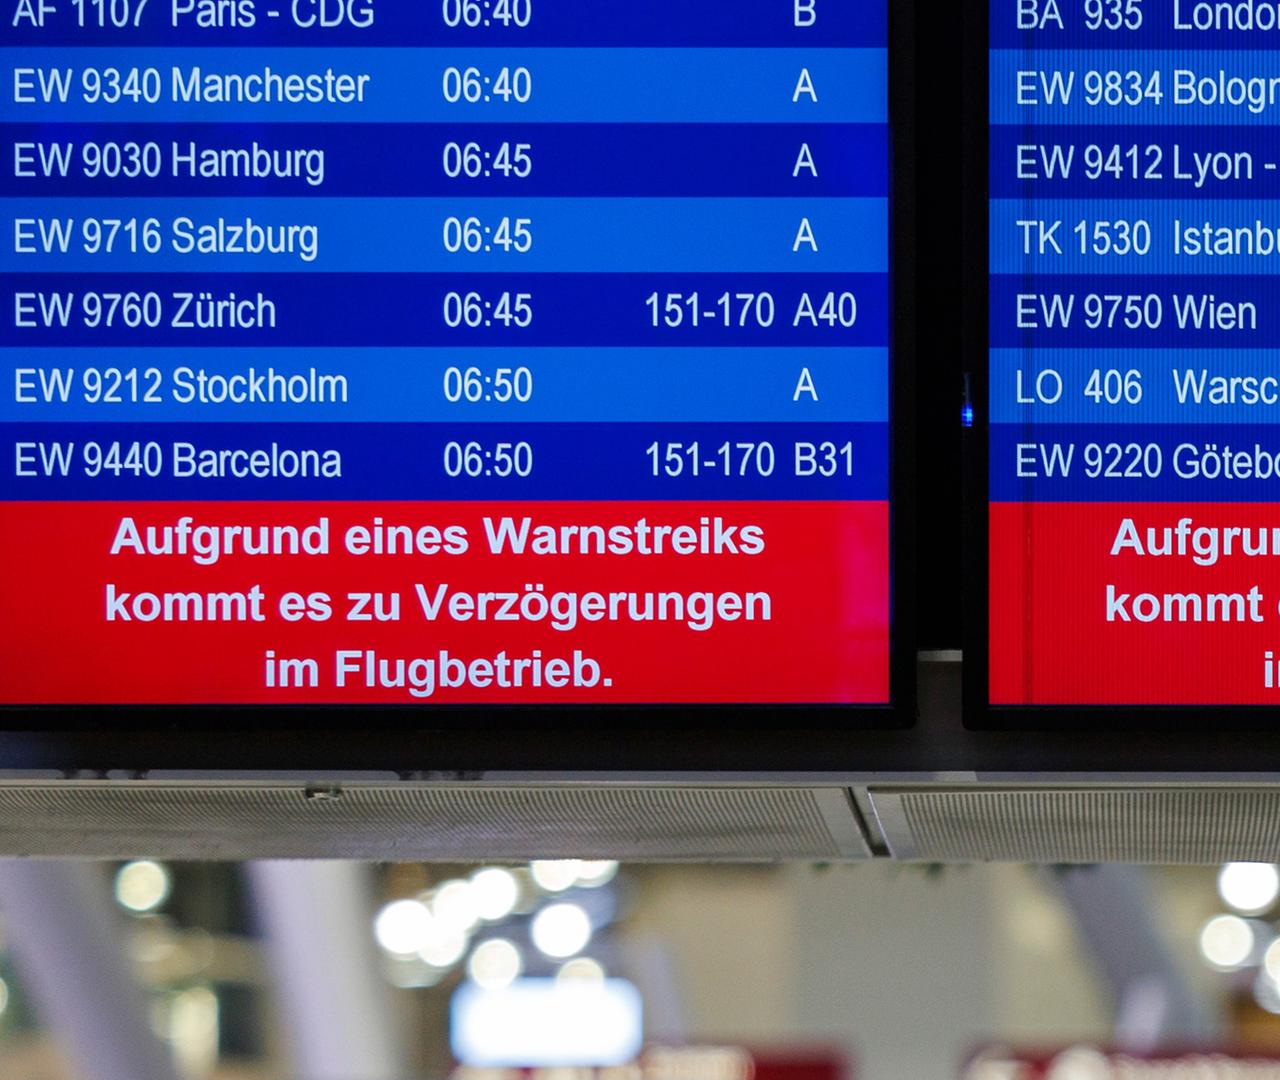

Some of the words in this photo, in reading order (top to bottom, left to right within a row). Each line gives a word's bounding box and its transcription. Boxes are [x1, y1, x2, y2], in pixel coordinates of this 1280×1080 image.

[14, 68, 73, 103] EW
[82, 67, 161, 104] 9340
[172, 66, 371, 103] Manchester
[442, 66, 532, 103] 06:40
[792, 68, 818, 103] A
[1017, 70, 1075, 105] EW
[1084, 70, 1164, 106] 9834
[14, 142, 73, 177] EW
[82, 141, 161, 178] 9030
[172, 141, 324, 186] Hamburg
[443, 142, 532, 178] 06:45
[792, 143, 818, 177] A
[15, 218, 74, 253] EW
[82, 217, 162, 254] 9716
[171, 216, 318, 262] Salzburg
[443, 216, 532, 253] 06:45
[792, 217, 818, 252] A
[15, 292, 74, 327] EW
[82, 291, 162, 328] 9760
[171, 292, 276, 328] Zürich
[443, 291, 533, 328] 06:45
[645, 291, 775, 328] 151-170
[792, 291, 857, 328] A40
[1016, 294, 1075, 328] EW
[1084, 293, 1163, 329] 9750
[1172, 294, 1256, 330] Wien
[15, 368, 74, 403] EW
[83, 367, 162, 403] 9212
[172, 366, 348, 403] Stockholm
[443, 366, 533, 402] 06:50
[793, 367, 819, 401] A
[1016, 369, 1063, 404] LO
[1083, 368, 1143, 404] 406
[15, 442, 74, 476] EW
[83, 441, 163, 477] 9440
[173, 442, 342, 478] Barcelona
[443, 441, 533, 477] 06:50
[646, 441, 775, 477] 151-170
[795, 441, 852, 477] B31
[1016, 443, 1075, 477] EW
[1084, 442, 1163, 478] 9220
[110, 516, 329, 566] Aufgrund
[344, 517, 469, 555] eines
[482, 516, 765, 555] Warnstreiks
[106, 583, 266, 622] kommt
[279, 591, 333, 622] es
[346, 592, 400, 622] zu
[414, 583, 771, 632] Verzögerungen
[1106, 584, 1264, 623] kommt
[265, 650, 319, 688] im
[335, 649, 613, 698] Flugbetrieb.
